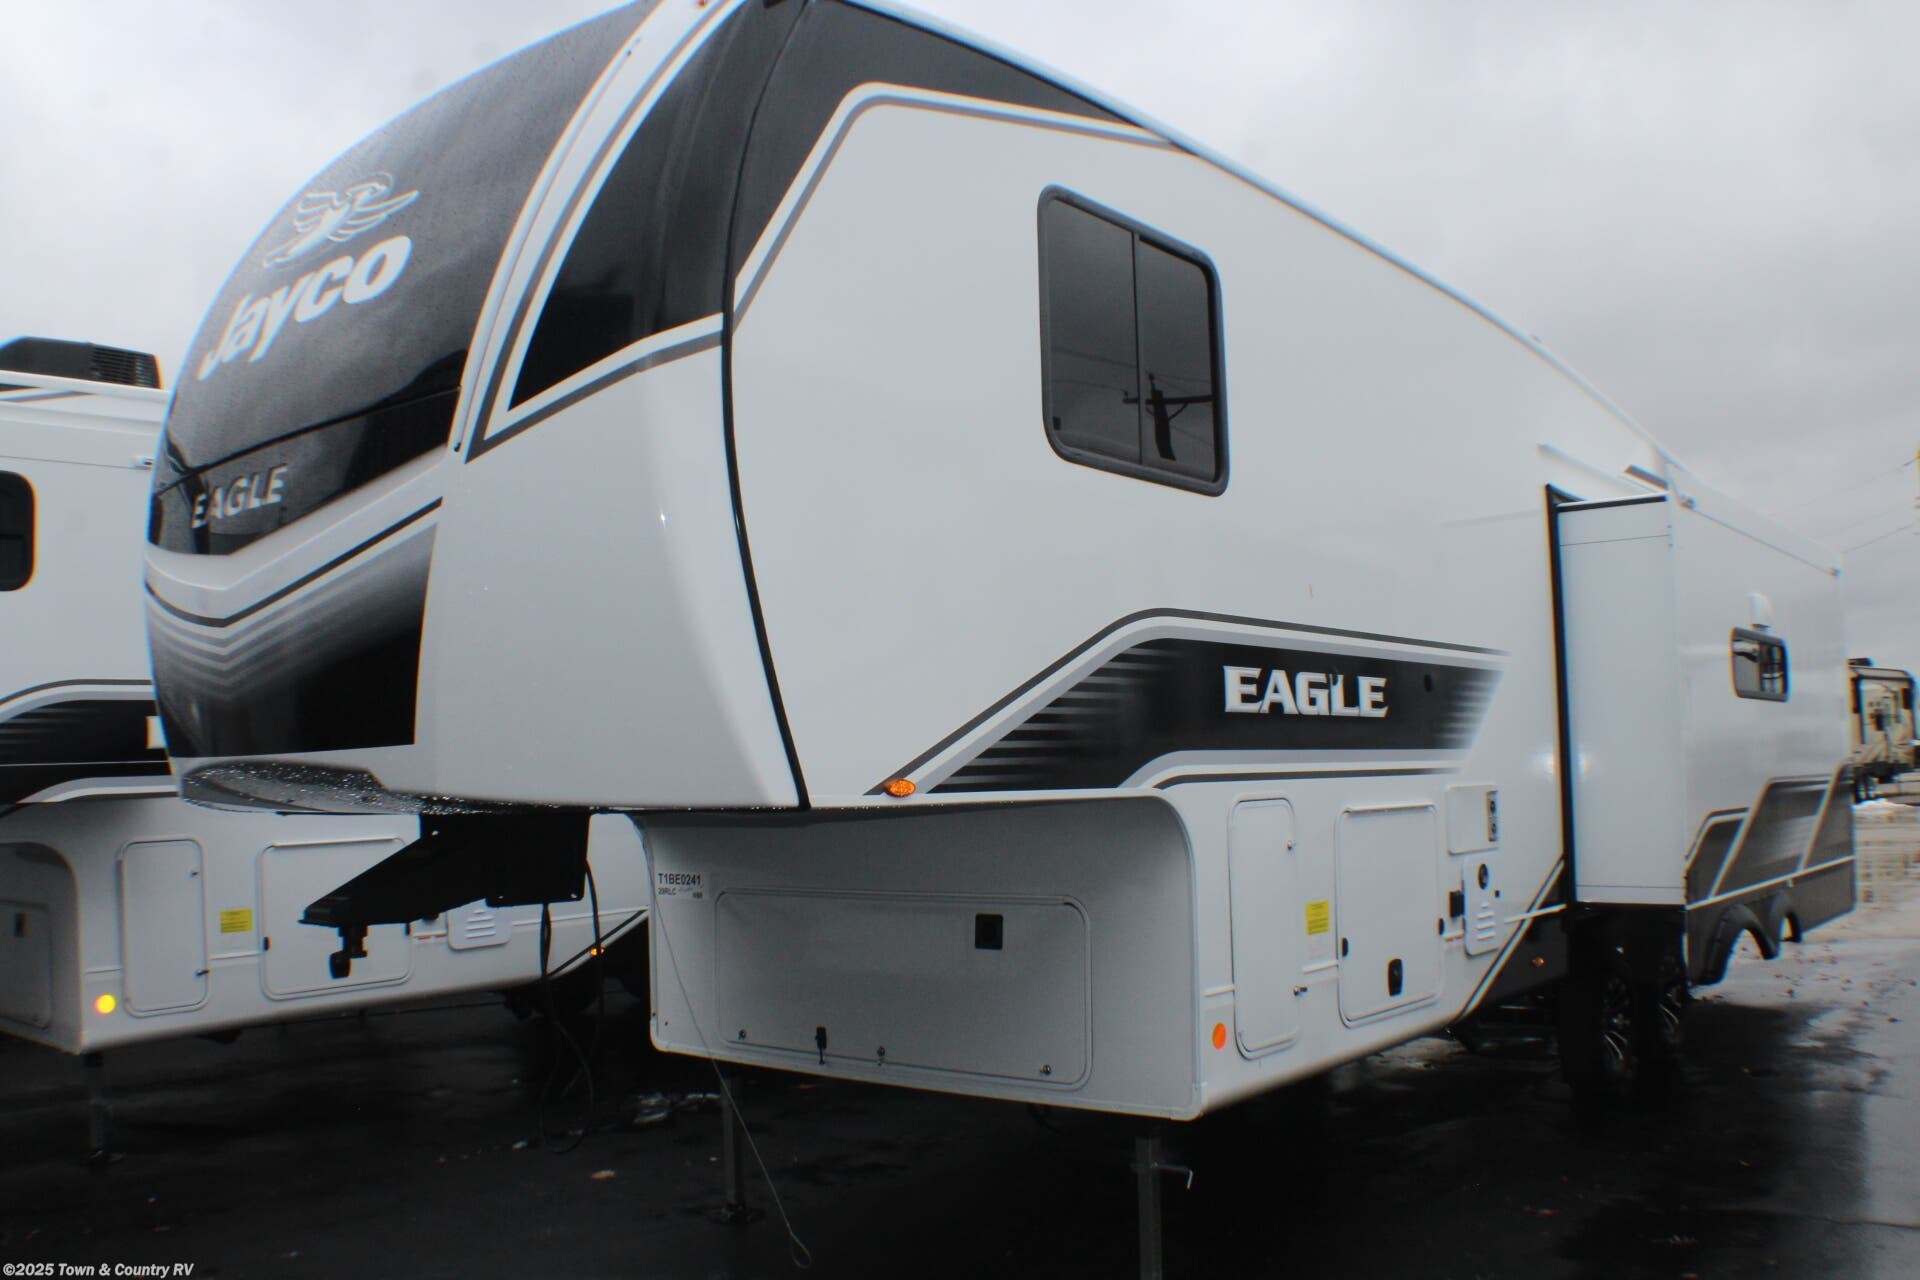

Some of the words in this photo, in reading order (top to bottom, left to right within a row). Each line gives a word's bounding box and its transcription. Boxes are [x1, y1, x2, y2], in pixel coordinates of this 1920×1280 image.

[196, 234, 413, 381] Jayco
[191, 464, 288, 529] EAGLE
[1223, 665, 1389, 718] EAGLE
